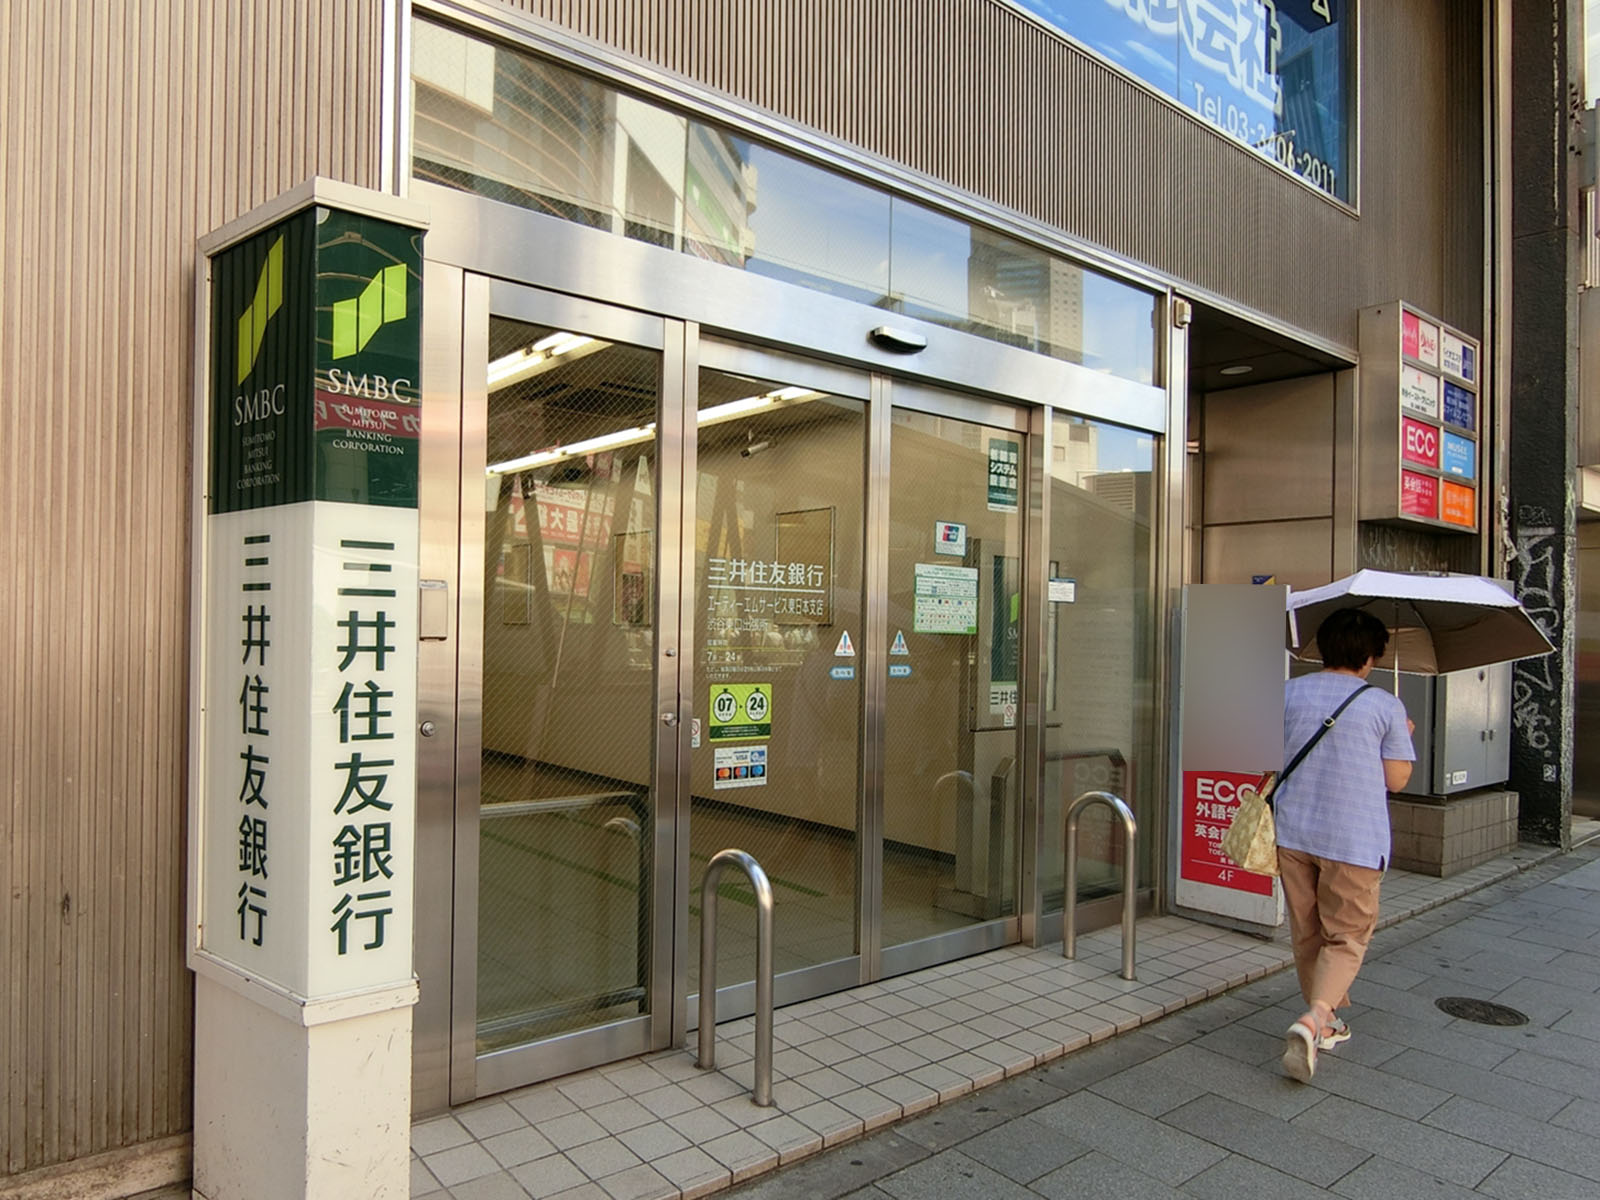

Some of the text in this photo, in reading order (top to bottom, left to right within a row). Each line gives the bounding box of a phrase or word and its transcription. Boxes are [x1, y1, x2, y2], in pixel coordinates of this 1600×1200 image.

[328, 368, 412, 404] SMBC
[234, 384, 286, 427] SMBC
[341, 404, 398, 420] SUMITOMO
[352, 418, 386, 431] MITSUI
[346, 429, 392, 443] BANKING
[1406, 425, 1436, 458] ECC
[332, 440, 404, 455] CORPORATION
[990, 461, 1017, 477] システム
[708, 558, 824, 587] 三井住友銀行
[718, 696, 765, 712] 07 24
[238, 534, 272, 947] 三井住友銀行
[331, 539, 397, 956] 三井住友銀行
[1218, 869, 1235, 882] 4F
